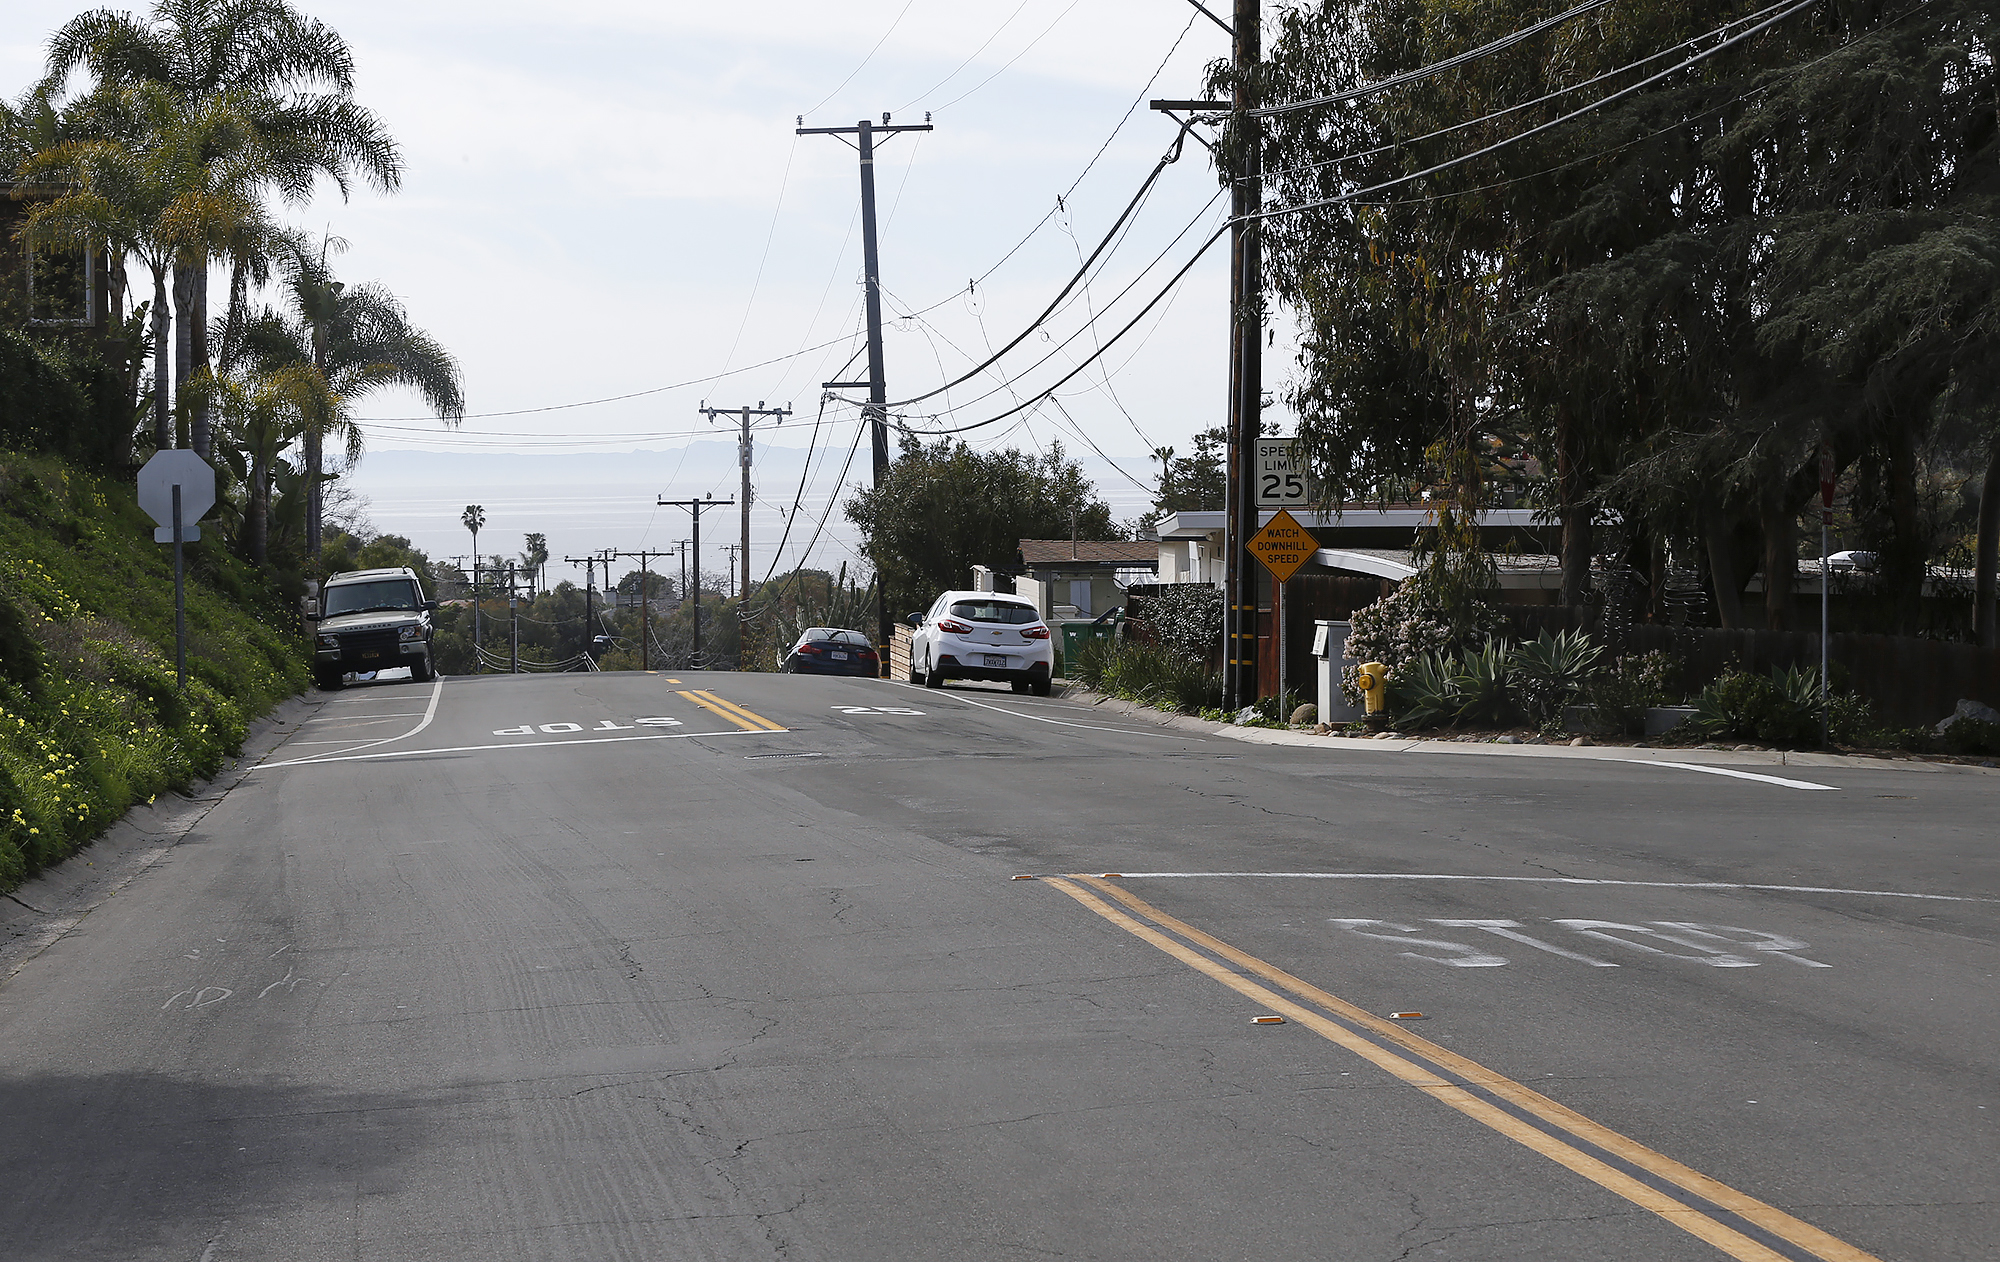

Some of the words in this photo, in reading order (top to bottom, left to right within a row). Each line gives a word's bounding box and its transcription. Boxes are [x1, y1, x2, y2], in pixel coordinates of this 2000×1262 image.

[1261, 474, 1304, 499] 25
[1266, 528, 1300, 538] WATCH
[1257, 541, 1309, 551] DOWNHILL
[1267, 554, 1299, 564] SPEED
[830, 706, 927, 716] 25
[492, 716, 684, 736] STOP
[1326, 917, 1833, 969] STOP
